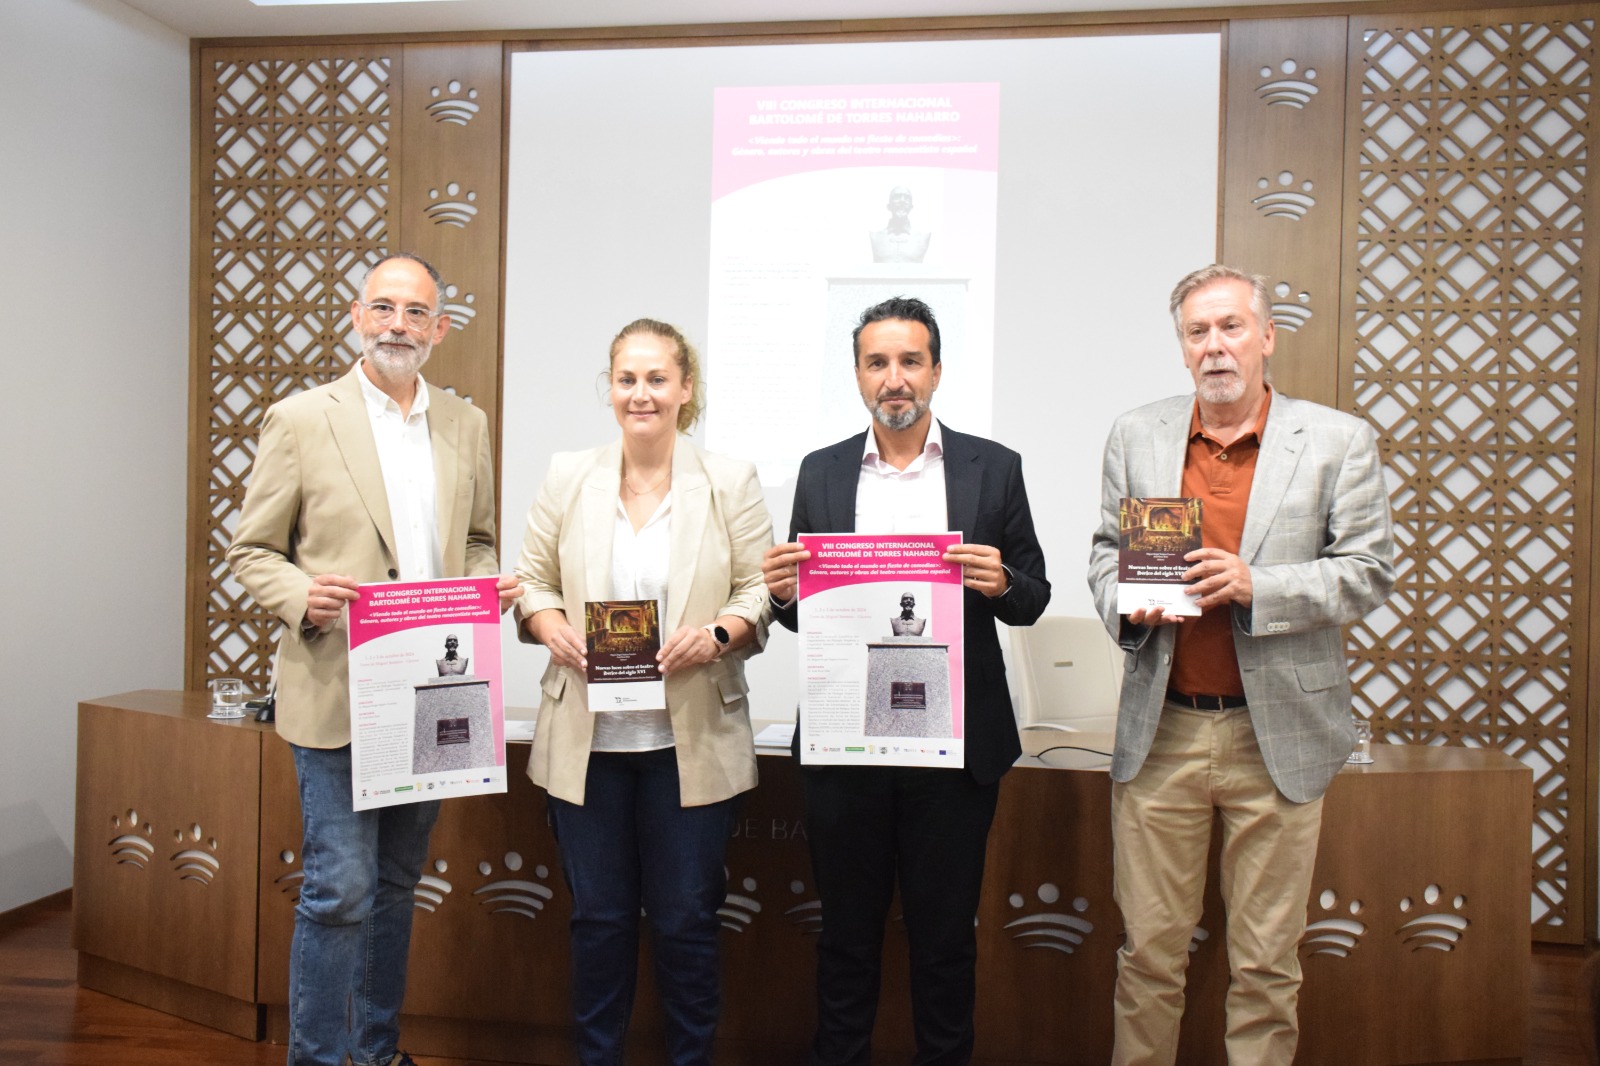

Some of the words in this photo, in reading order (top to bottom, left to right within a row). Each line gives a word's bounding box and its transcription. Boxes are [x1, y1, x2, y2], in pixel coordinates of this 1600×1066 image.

[757, 100, 776, 110] VIII
[780, 98, 847, 110] CONGRESO
[850, 98, 952, 108] INTERNACIONAL
[749, 111, 823, 124] BARTOLOMÉ
[827, 113, 842, 124] DE
[846, 112, 892, 123] TORRES
[896, 112, 960, 122] NAHARRO
[386, 589, 422, 598] CONGRESO
[424, 586, 477, 595] INTERNACIONAL
[369, 596, 410, 606] BARTOLOMÉ
